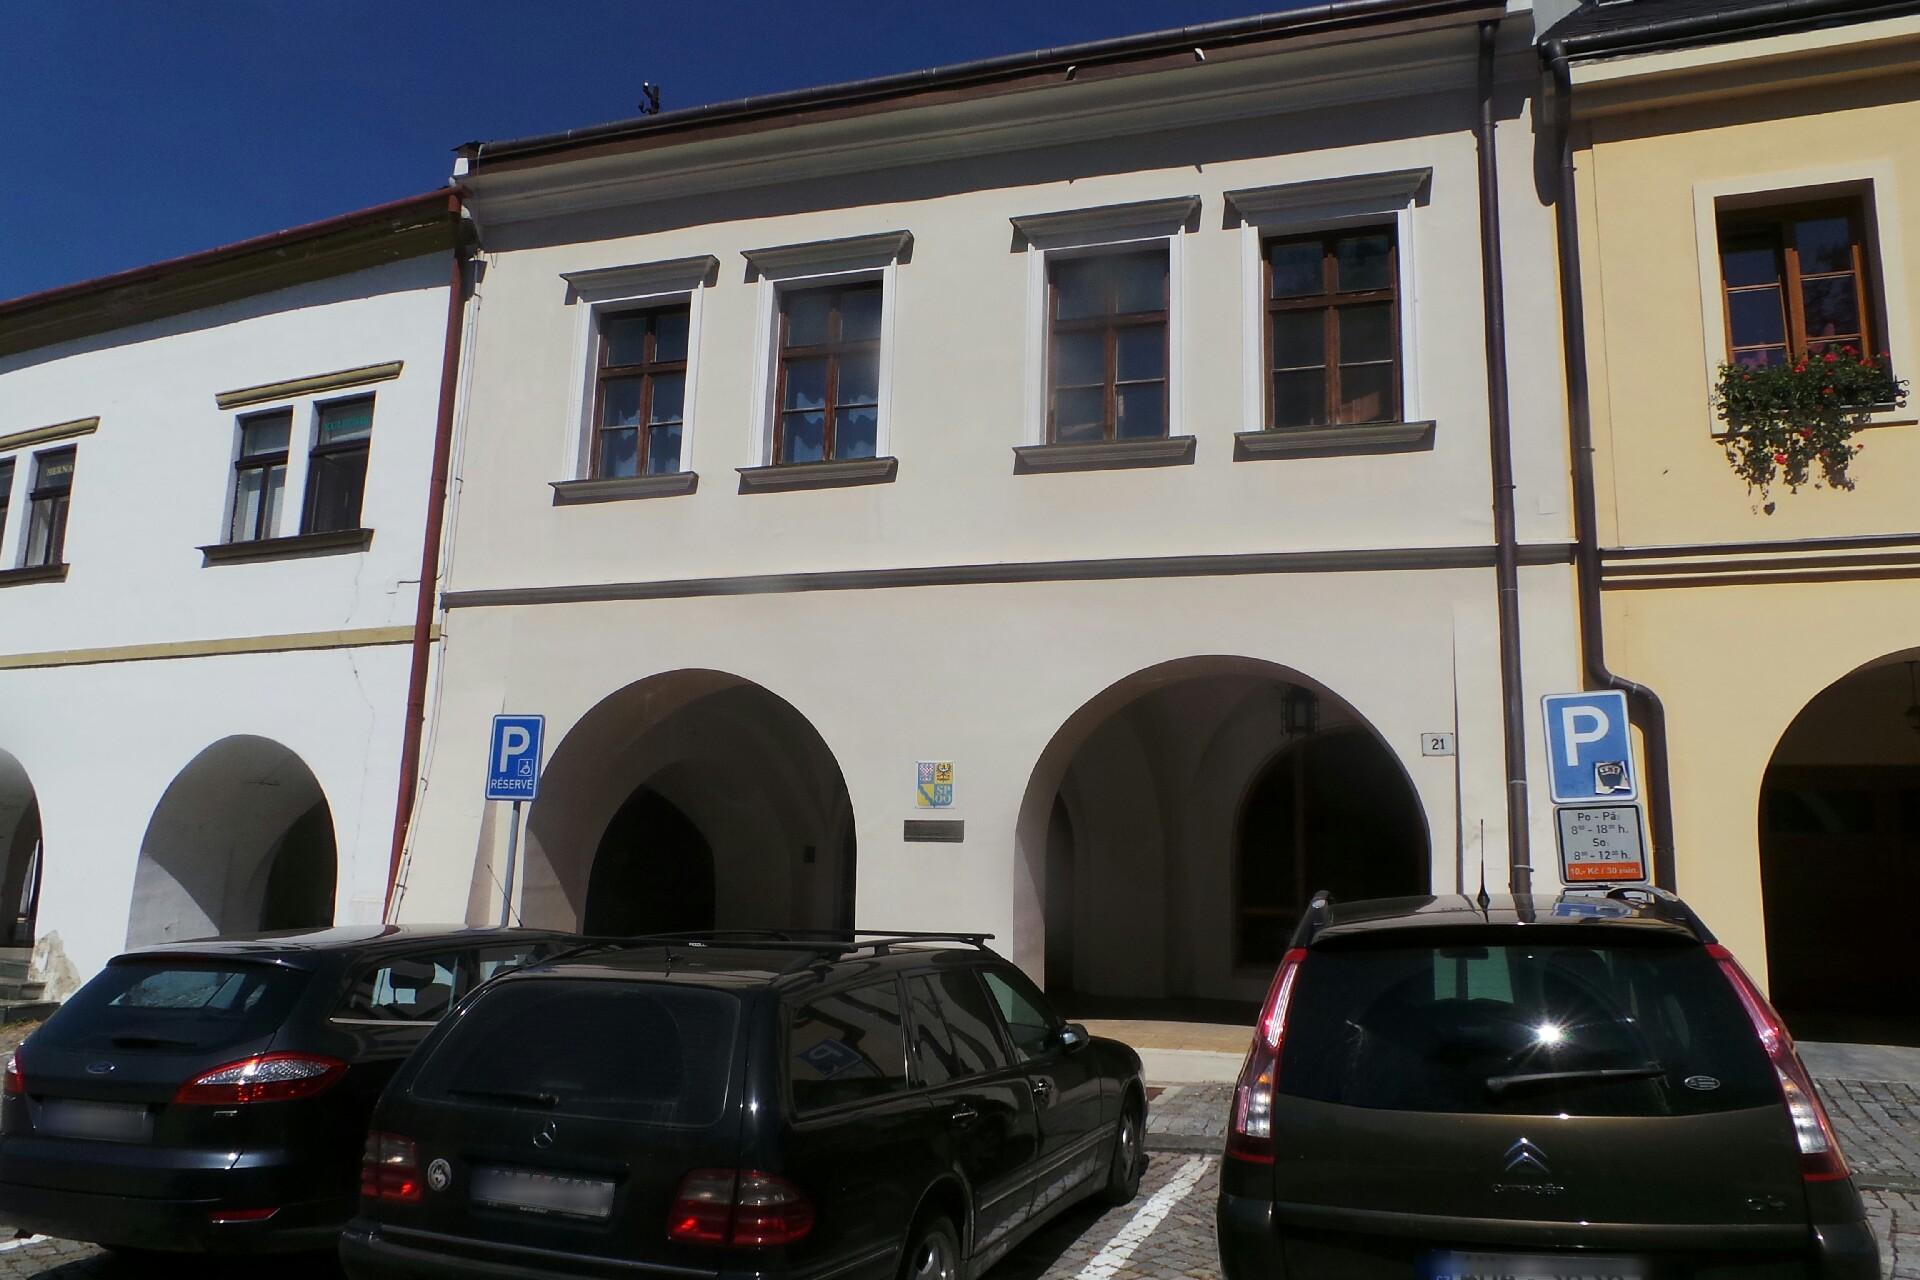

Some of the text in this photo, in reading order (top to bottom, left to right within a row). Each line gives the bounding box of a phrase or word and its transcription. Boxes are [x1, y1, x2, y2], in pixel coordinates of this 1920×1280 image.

[499, 726, 531, 773] P
[1431, 737, 1445, 750] 21
[1562, 705, 1610, 767] P
[1577, 812, 1591, 821] Po
